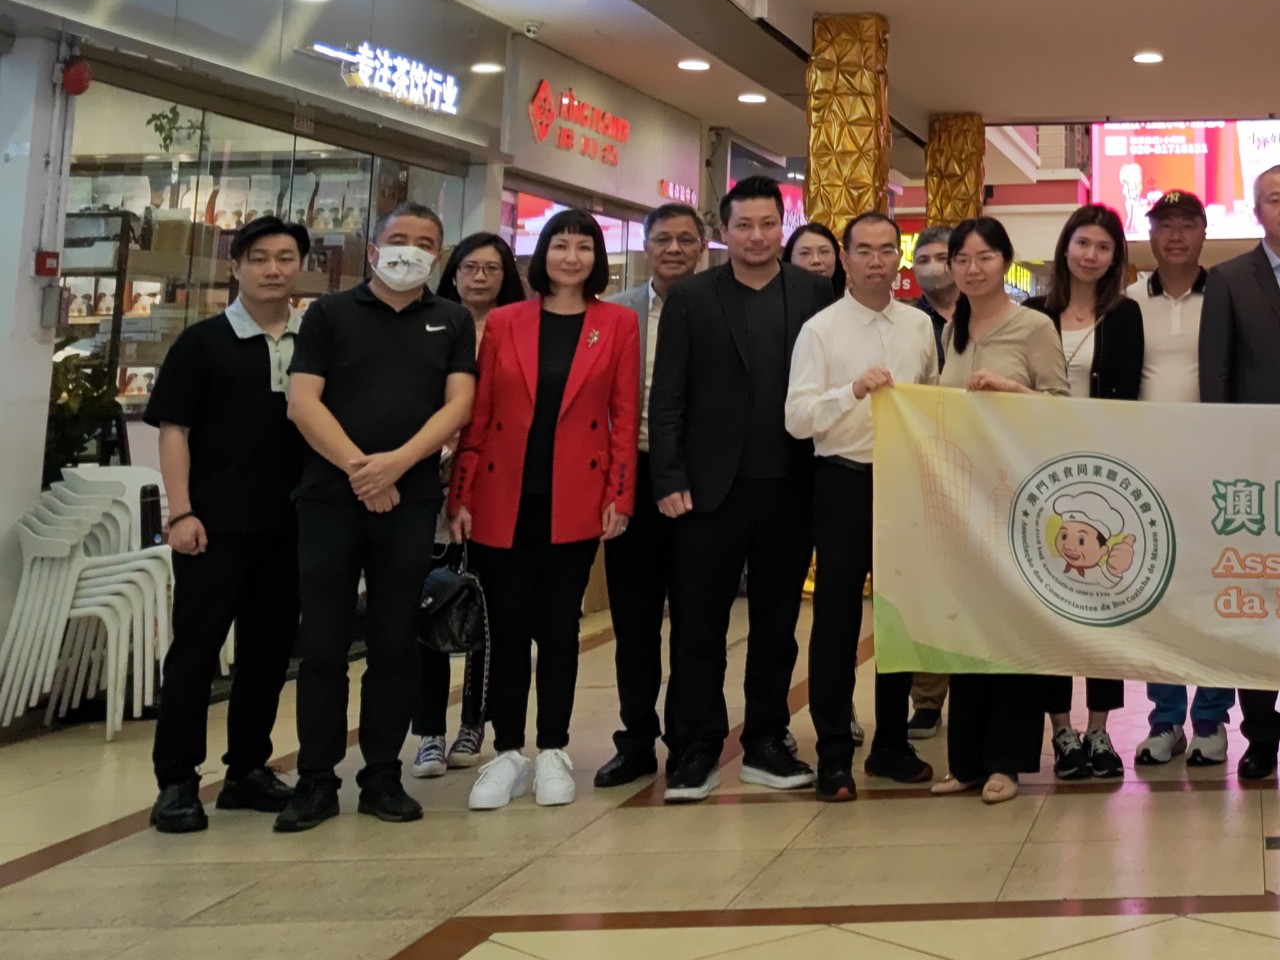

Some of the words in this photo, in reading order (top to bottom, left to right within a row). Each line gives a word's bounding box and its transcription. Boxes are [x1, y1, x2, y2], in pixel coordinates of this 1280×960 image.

[1100, 603, 1112, 612] da
[1126, 576, 1151, 603] Cozinha
[1149, 561, 1156, 576] de
[1214, 586, 1269, 619] da
